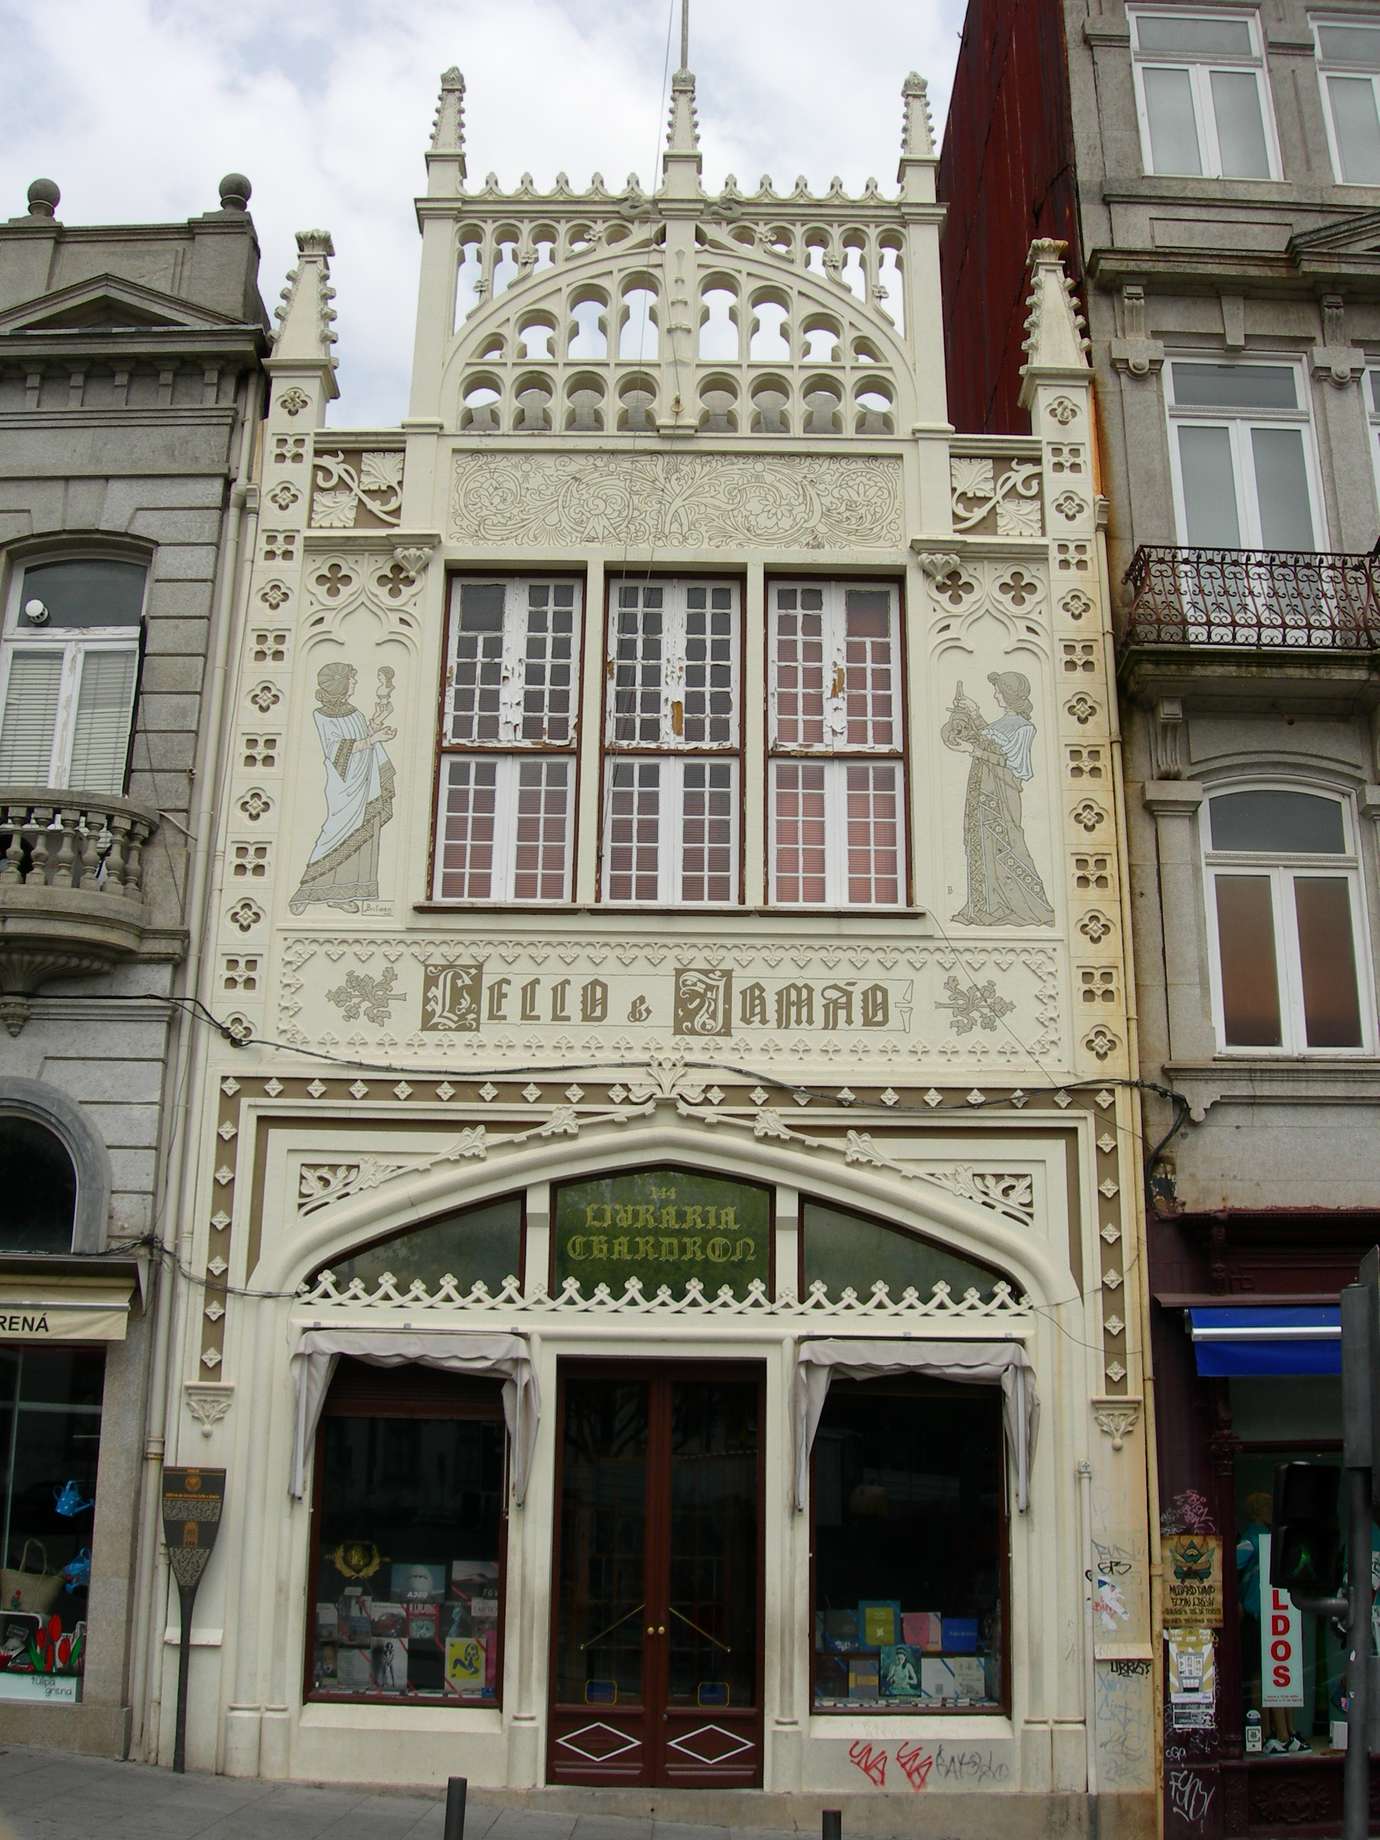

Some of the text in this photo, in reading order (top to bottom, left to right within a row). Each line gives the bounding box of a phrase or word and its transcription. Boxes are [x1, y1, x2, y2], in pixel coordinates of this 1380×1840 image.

[627, 995, 653, 1023] &
[585, 1203, 741, 1230] LIVRARIA
[1271, 1589, 1292, 1688] LDOS
